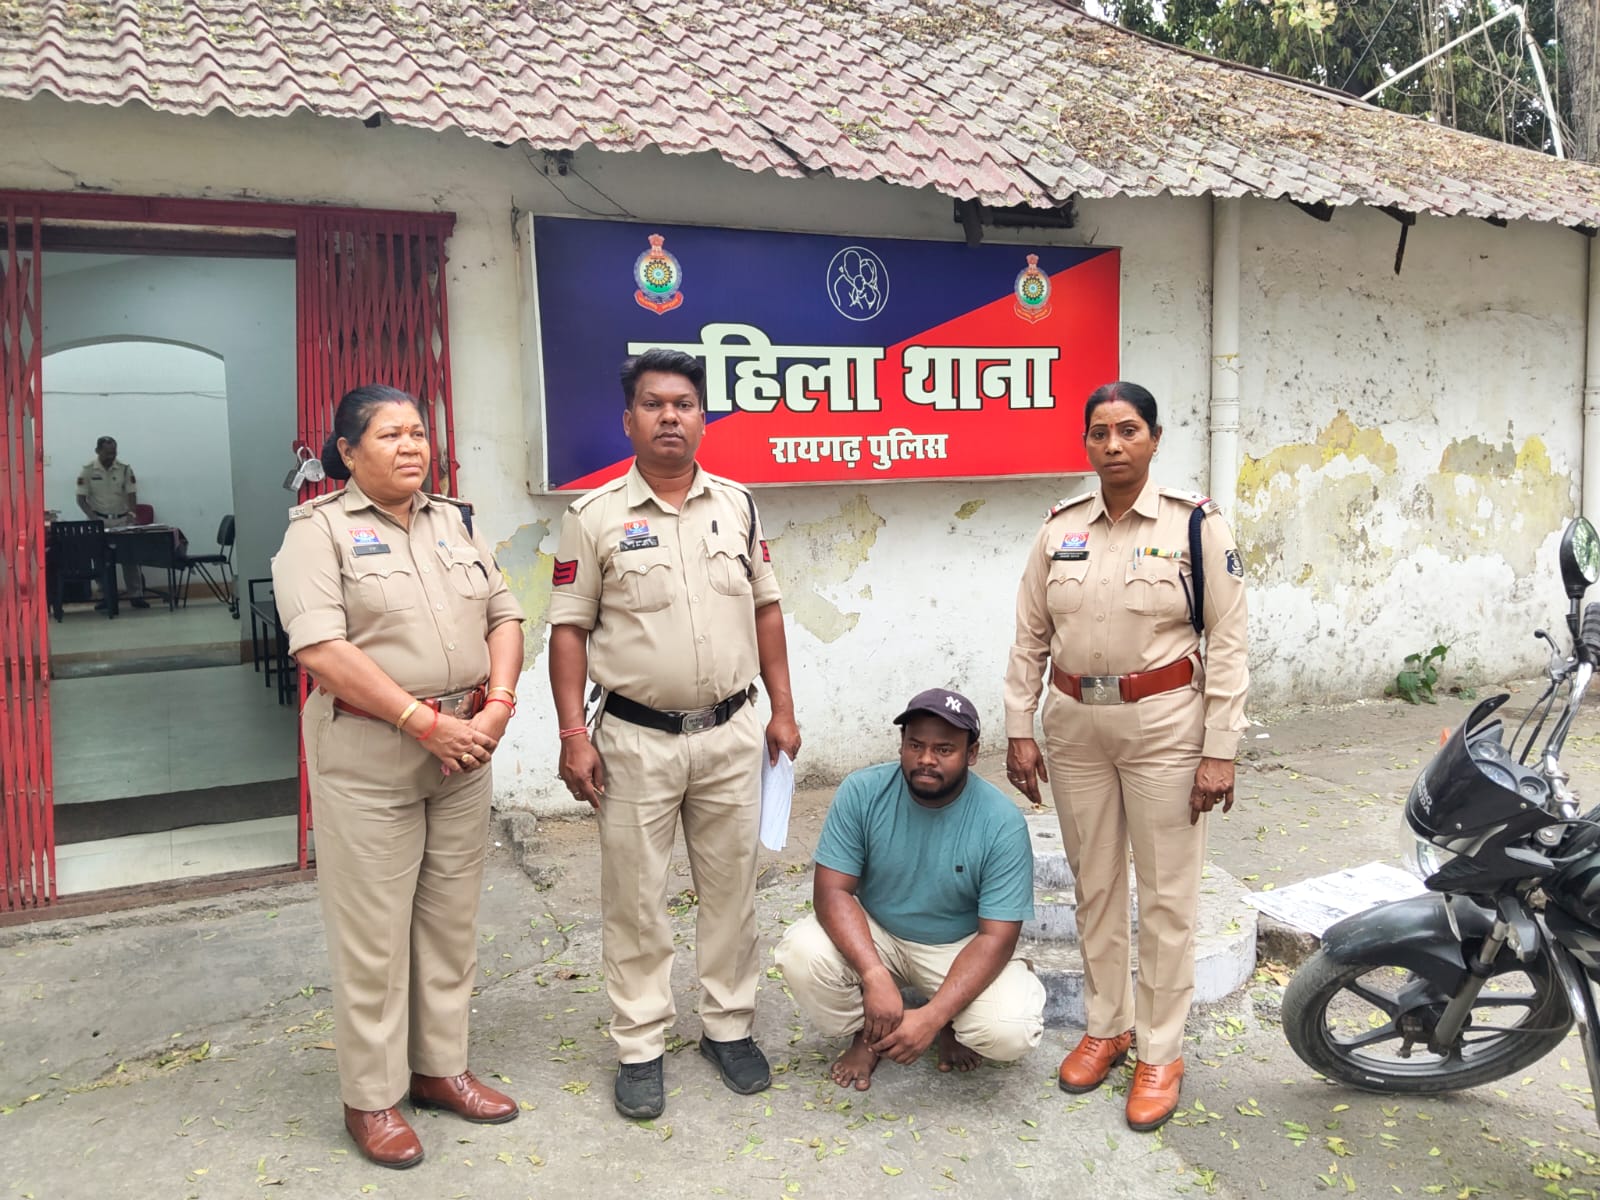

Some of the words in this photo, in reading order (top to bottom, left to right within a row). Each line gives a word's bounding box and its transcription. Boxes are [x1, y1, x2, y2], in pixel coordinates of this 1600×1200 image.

[627, 322, 886, 413] हिला
[902, 344, 1060, 411] थाना
[768, 435, 863, 469] रायगढ़
[866, 427, 949, 470] पुलिस
